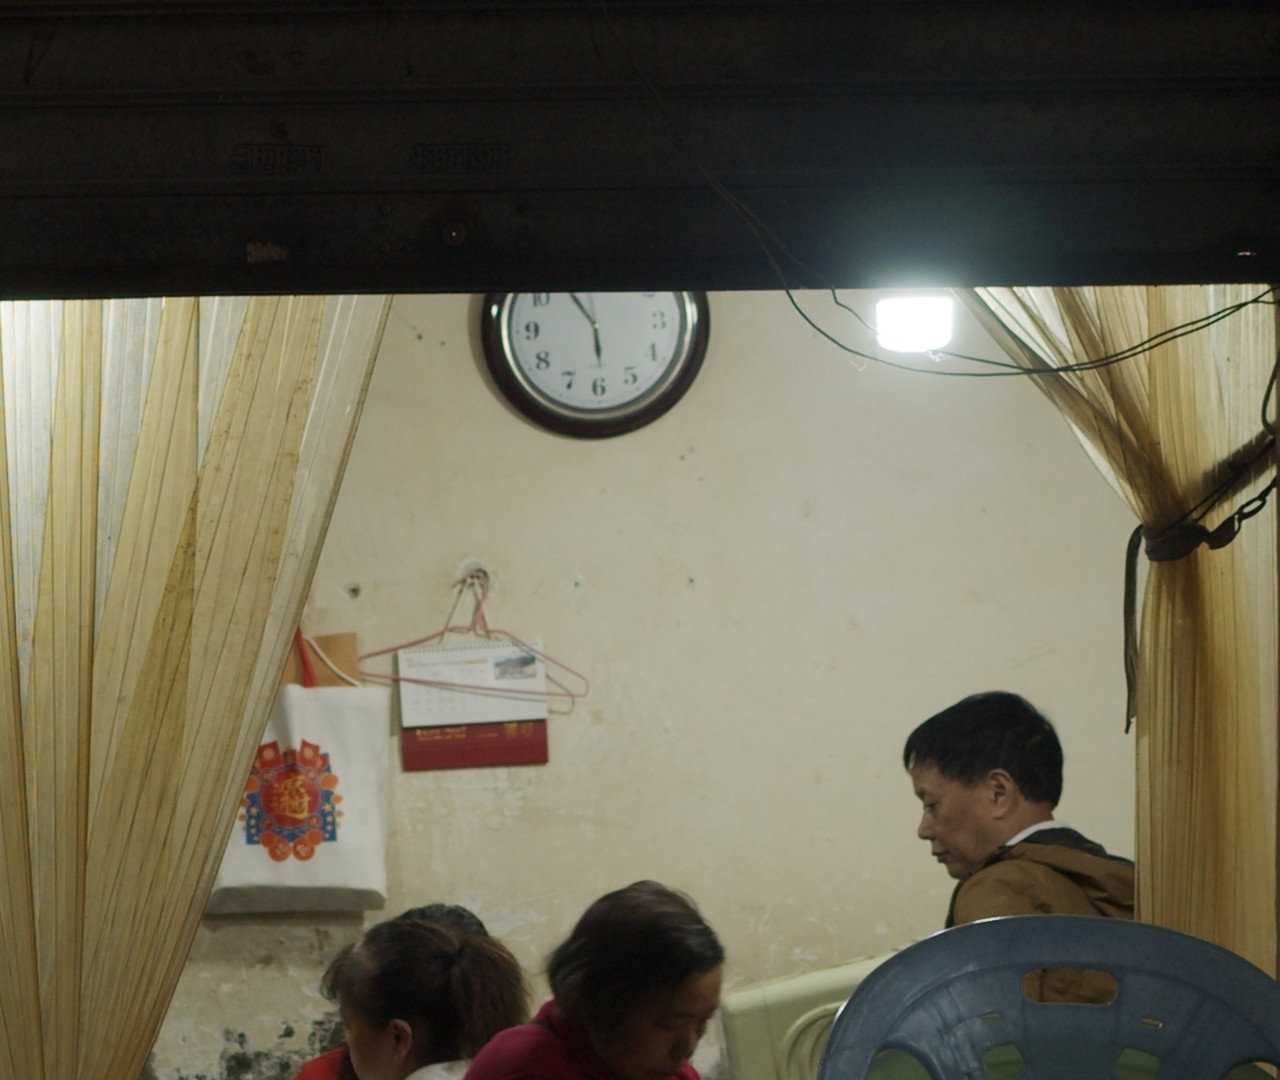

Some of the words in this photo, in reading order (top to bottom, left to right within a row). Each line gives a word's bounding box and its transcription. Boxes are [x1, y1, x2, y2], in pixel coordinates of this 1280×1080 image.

[525, 322, 539, 340] 9
[652, 311, 666, 330] 3
[536, 351, 550, 370] 8
[645, 343, 658, 361] 4
[562, 371, 576, 389] 7
[592, 377, 605, 396] 6
[623, 366, 637, 384] 5
